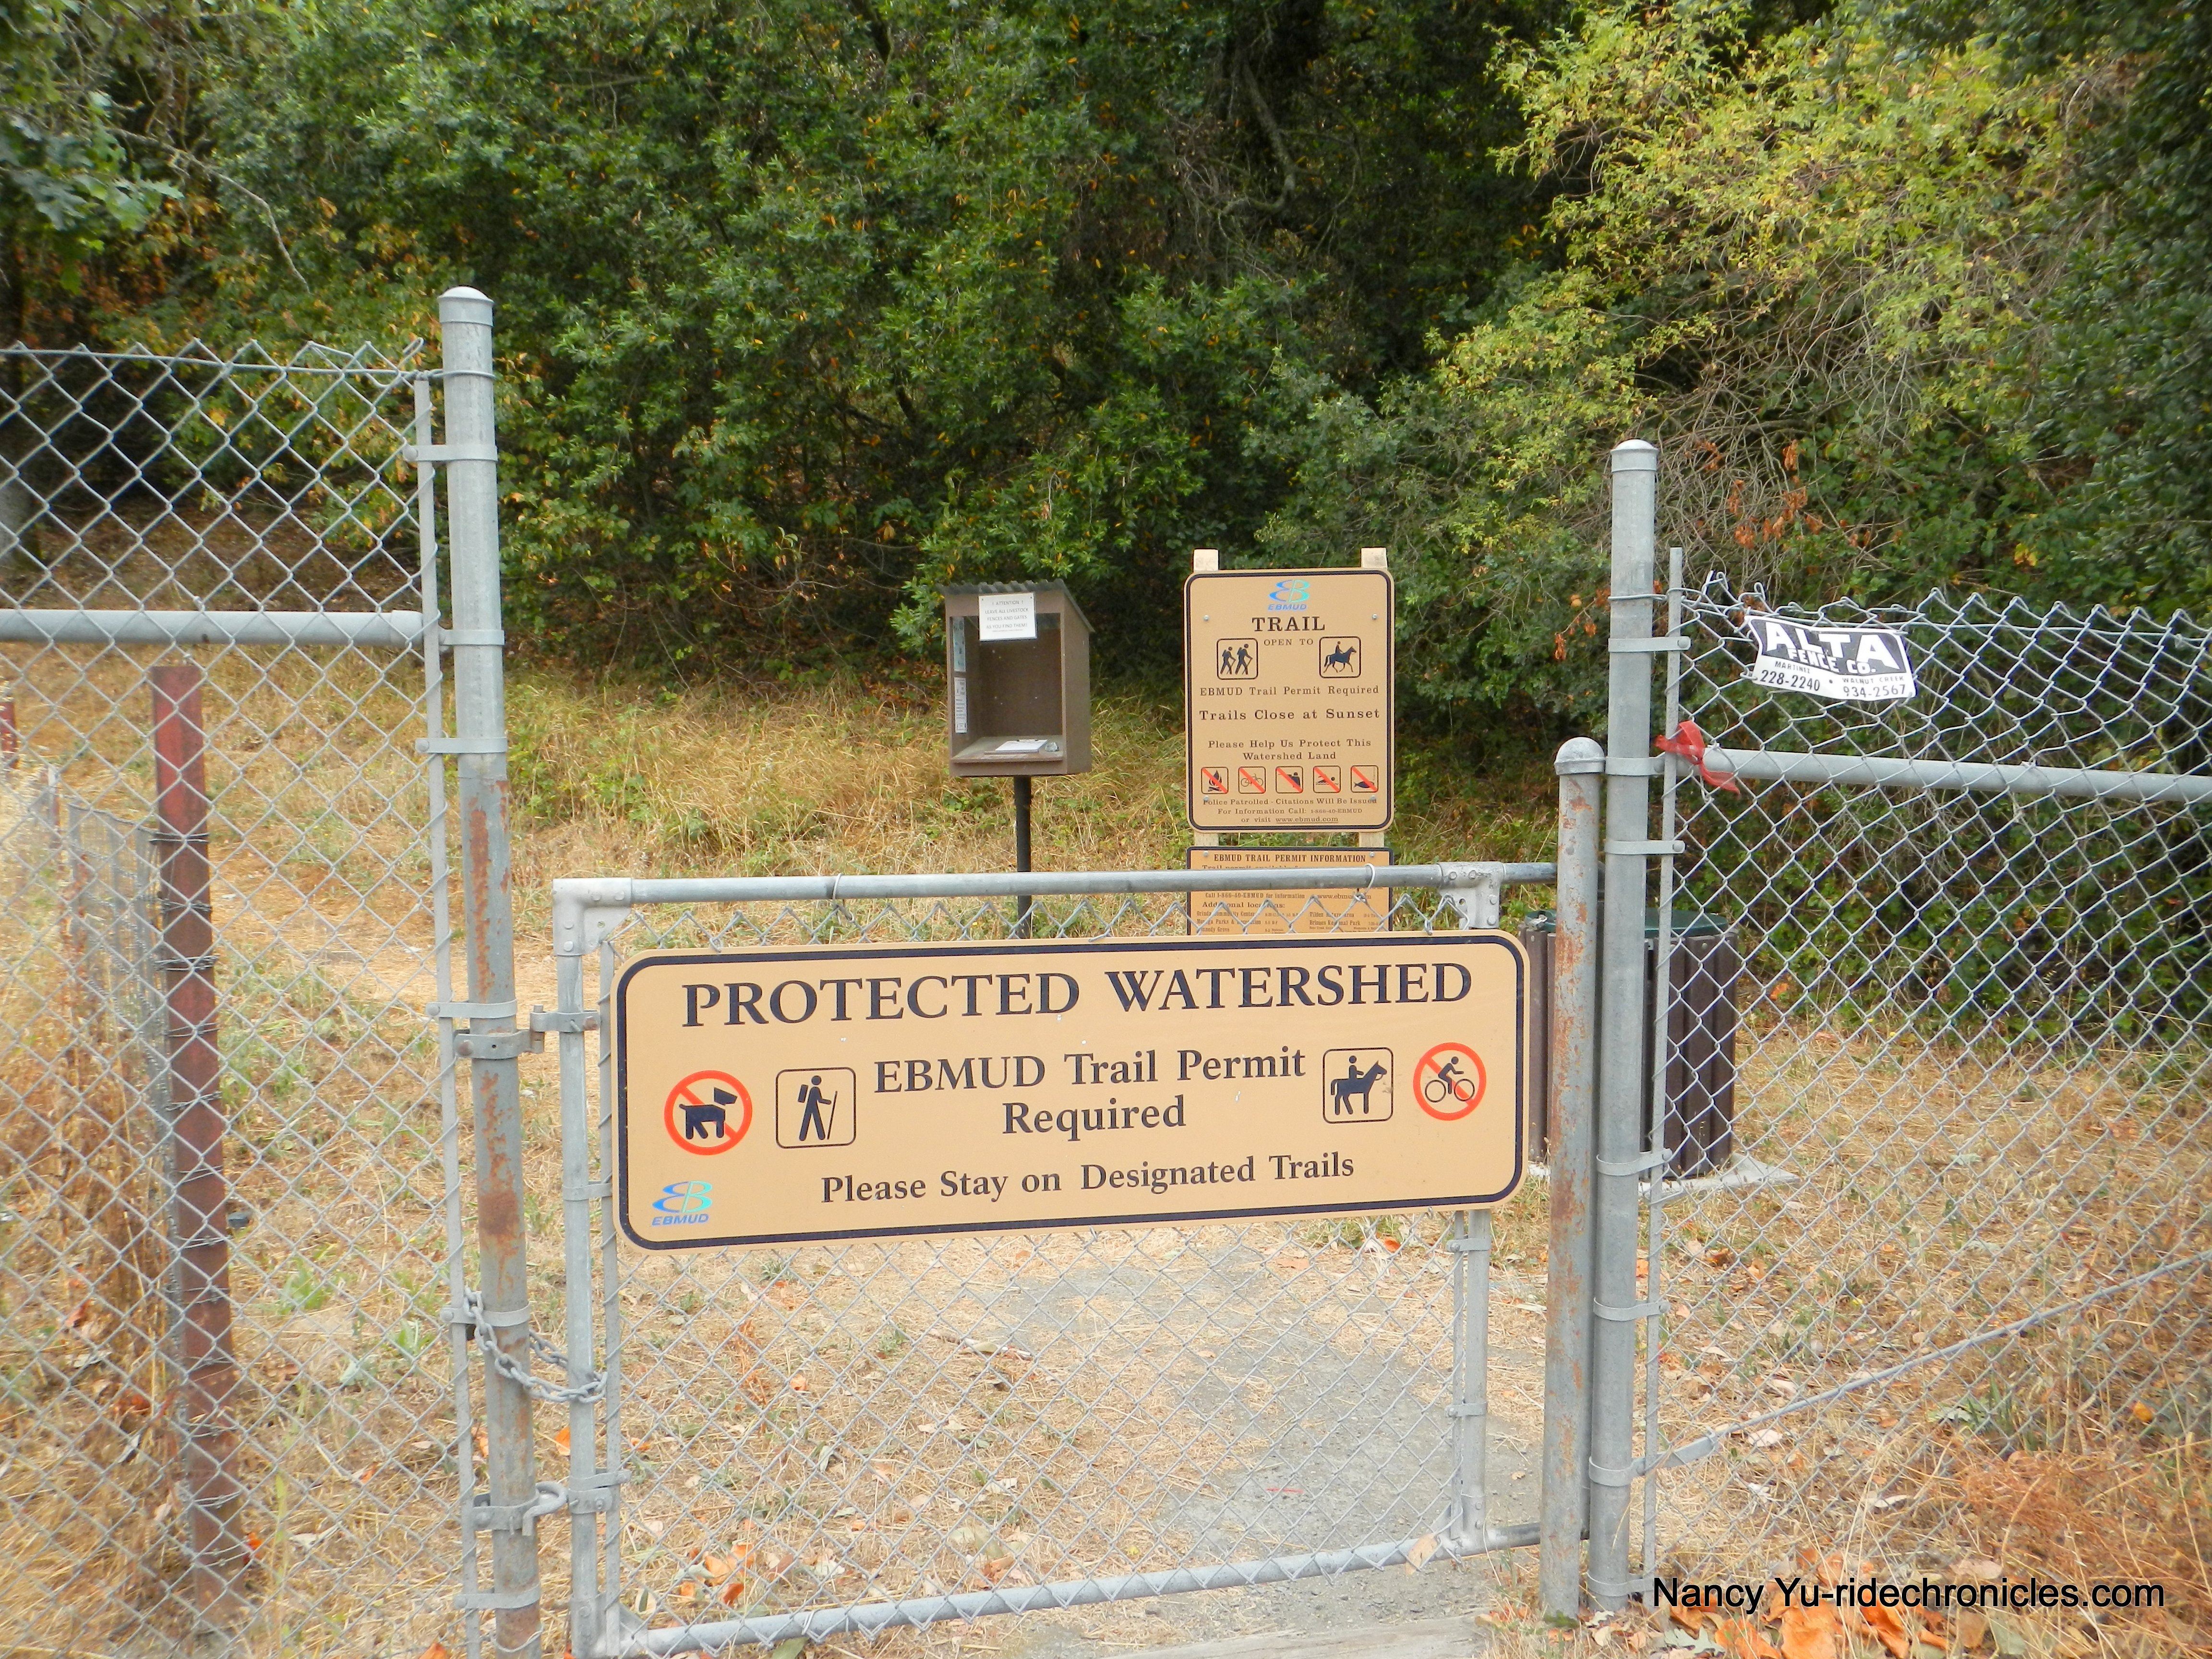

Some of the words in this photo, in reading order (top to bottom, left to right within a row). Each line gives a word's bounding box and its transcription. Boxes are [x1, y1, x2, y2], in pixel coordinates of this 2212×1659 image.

[1252, 616, 1325, 632] TRAIL
[1766, 622, 1900, 669] ALTA
[1775, 661, 1810, 674] MARTINEZ
[1787, 648, 1839, 672] FENCE
[1846, 659, 1876, 674] CO.
[1760, 670, 1820, 691] 228-2240
[1200, 687, 1243, 696] EBMUD
[1249, 687, 1277, 695] Trail
[1283, 686, 1321, 695] Permit
[1328, 685, 1379, 697] Required
[1843, 684, 1906, 697] 934-2567
[1199, 709, 1247, 720] Trails
[1254, 709, 1295, 720] Close
[1303, 709, 1317, 719] at
[1326, 708, 1380, 719] Sunset
[1208, 740, 1244, 748] Please
[1250, 740, 1275, 749] Help
[1280, 739, 1294, 747] Us
[1299, 739, 1341, 747] Protect
[1346, 739, 1371, 747] This
[1243, 752, 1302, 760] Watershed
[1308, 751, 1336, 759] Land
[681, 972, 1080, 1027] PROTECTED
[1104, 962, 1472, 1012] WATERSHED
[874, 1055, 1045, 1094] EBMUD
[1064, 1050, 1157, 1086] Trail
[1177, 1046, 1306, 1081] Permit
[1002, 1094, 1186, 1142] Required
[821, 1174, 926, 1203] Please
[939, 1170, 1009, 1202] Stay
[1021, 1172, 1061, 1192] on
[1080, 1156, 1256, 1195] Designated
[1269, 1152, 1355, 1180] Trails
[651, 1214, 709, 1226] EBMUD
